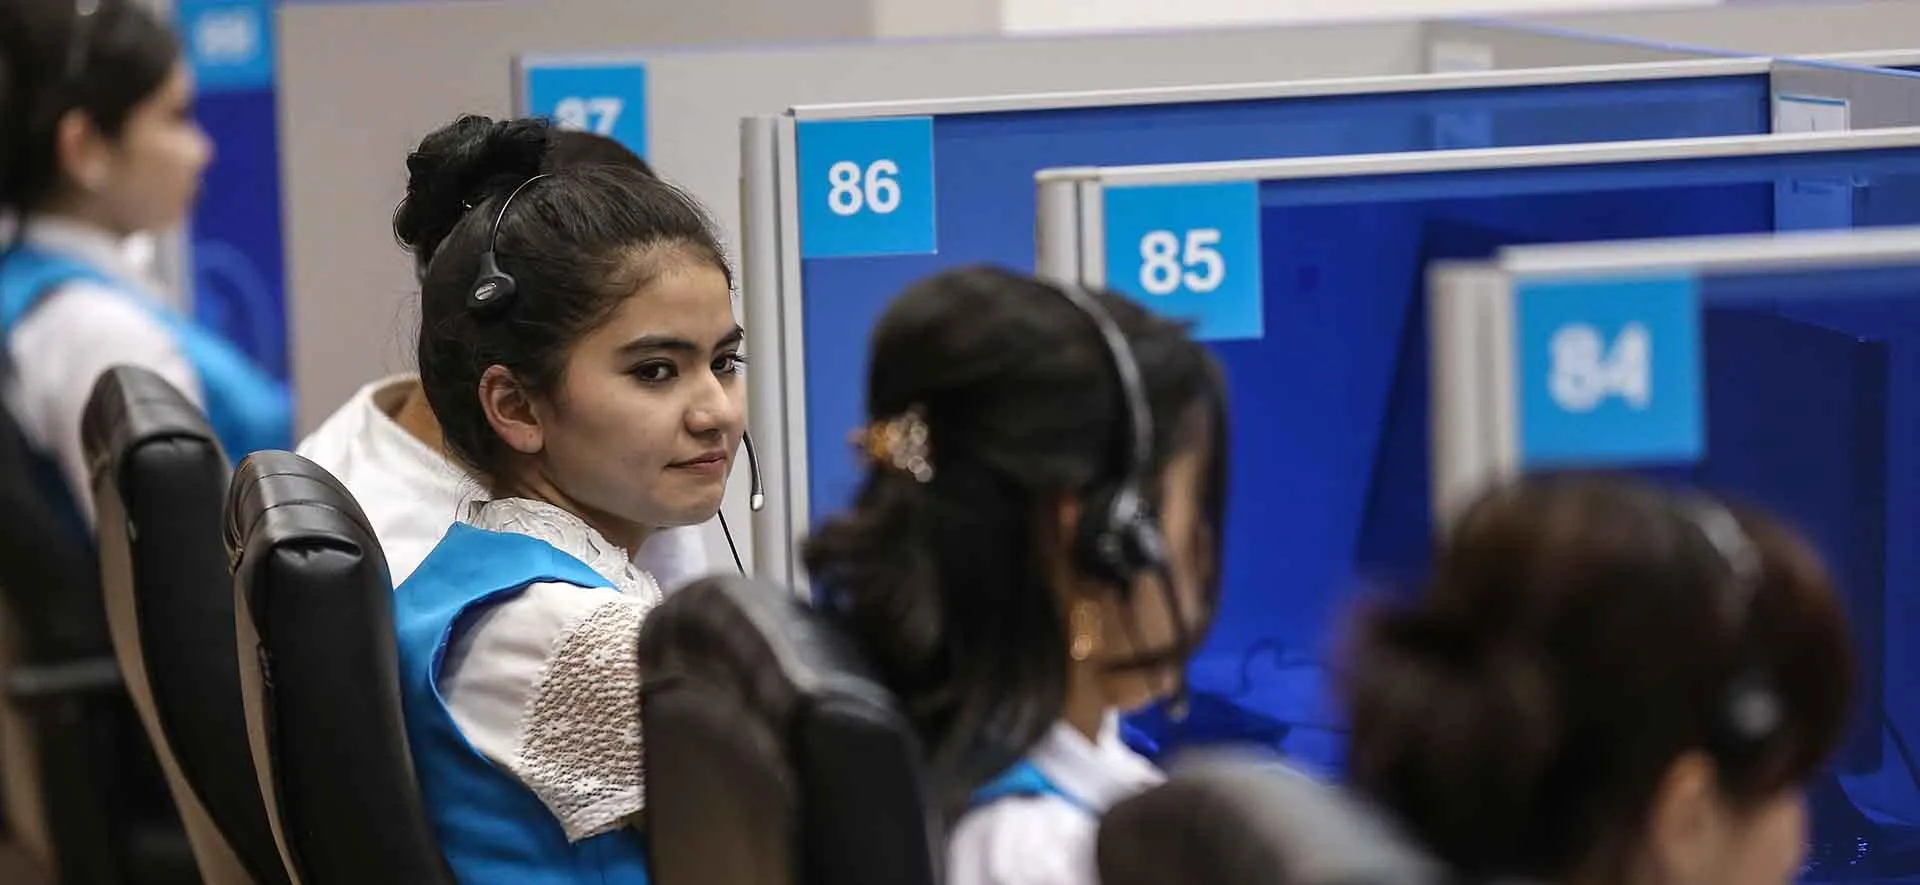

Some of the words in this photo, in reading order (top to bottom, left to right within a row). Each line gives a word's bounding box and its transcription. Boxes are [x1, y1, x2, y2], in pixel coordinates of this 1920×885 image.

[828, 160, 901, 216] 86
[1140, 229, 1225, 295] 85
[1549, 322, 1651, 412] 84
